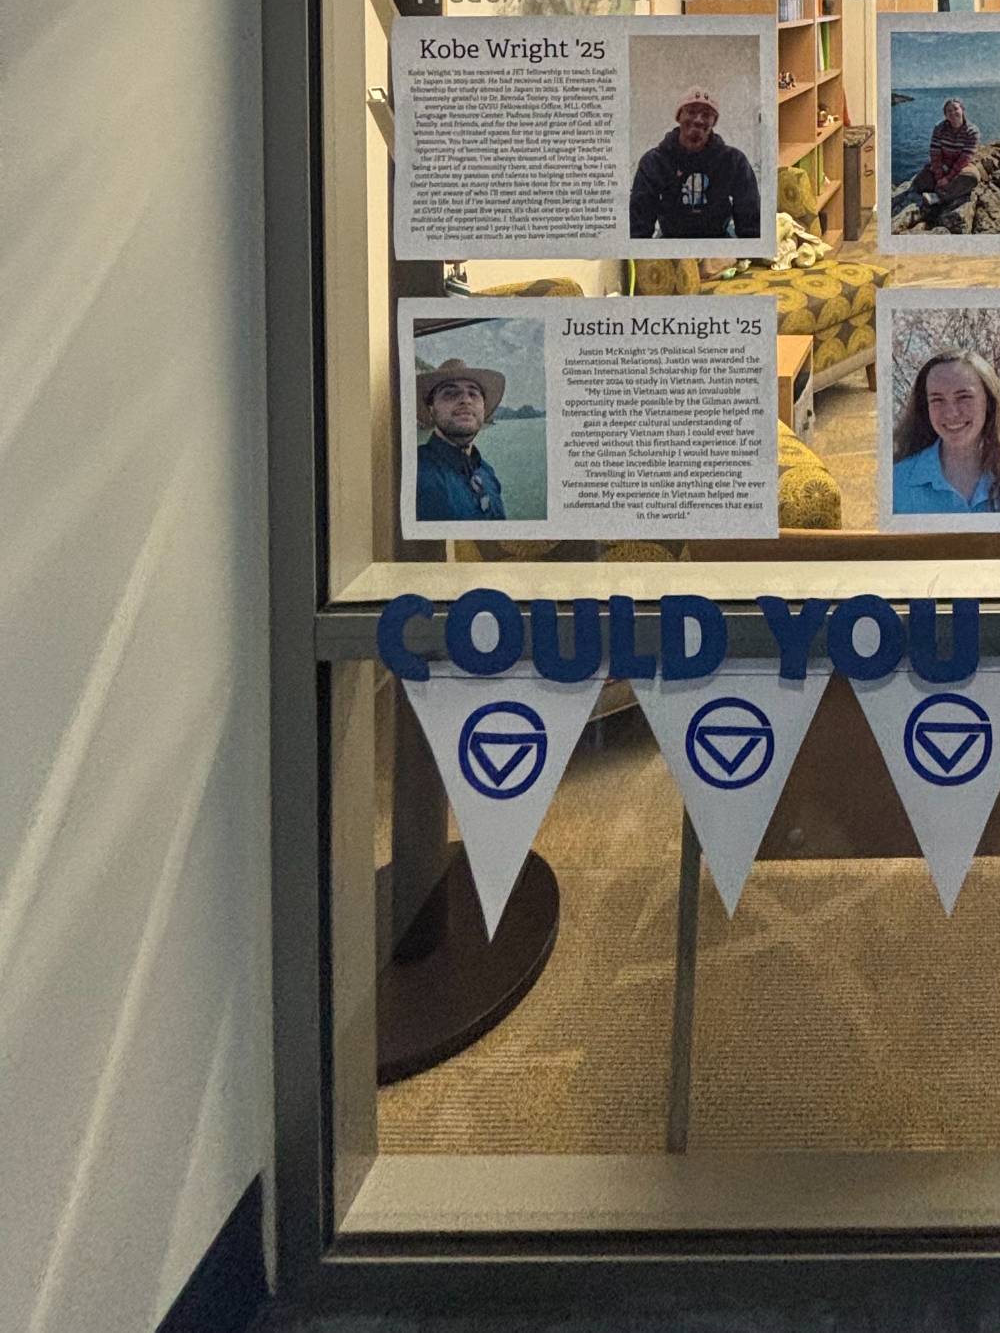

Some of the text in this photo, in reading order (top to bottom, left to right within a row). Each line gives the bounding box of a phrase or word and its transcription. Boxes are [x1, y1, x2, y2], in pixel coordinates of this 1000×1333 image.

[420, 37, 606, 64] Kobe Wright '25
[562, 316, 763, 340] Justin McKnight '25
[377, 588, 727, 683] COULD
[757, 594, 980, 684] YOU
